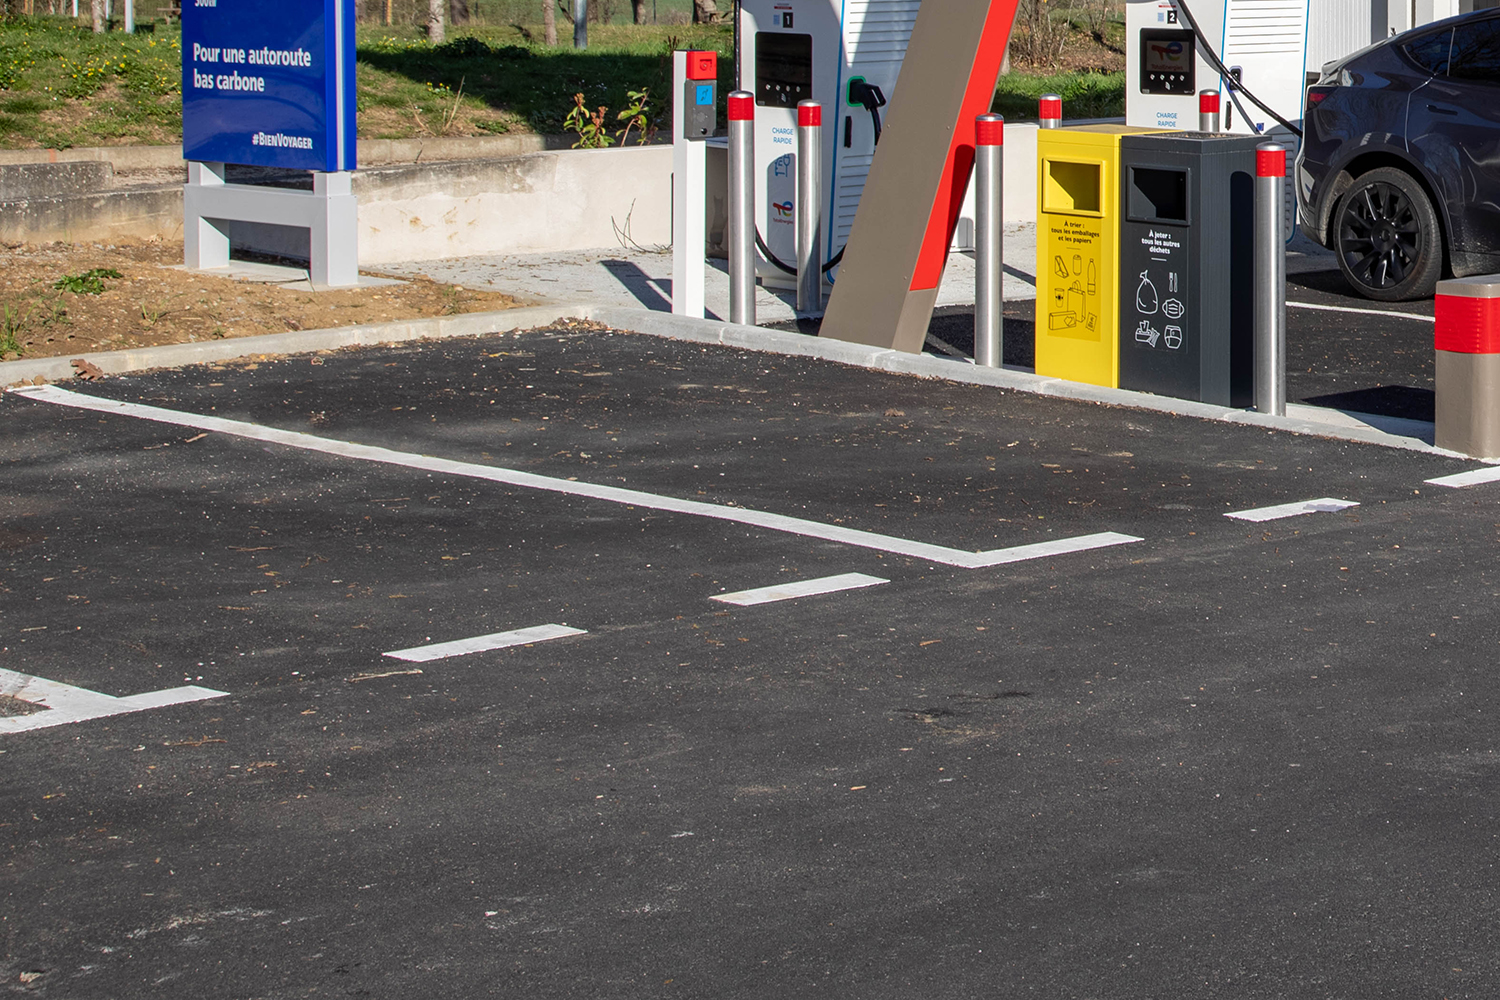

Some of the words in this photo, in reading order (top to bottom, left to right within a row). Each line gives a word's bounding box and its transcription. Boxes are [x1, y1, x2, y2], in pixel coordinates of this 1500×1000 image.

[1169, 12, 1175, 22] 2
[193, 43, 220, 63] Pour
[222, 48, 245, 64] une
[248, 46, 312, 67] autoroute
[193, 68, 214, 89] bas
[216, 70, 265, 92] carbone
[772, 127, 794, 135] CHARGE
[773, 137, 792, 145] RAPIDE
[1072, 229, 1100, 238] emballages
[1154, 231, 1168, 239] jeter
[1141, 237, 1153, 245] tous
[1154, 238, 1162, 246] les
[1163, 240, 1181, 248] autres
[1149, 245, 1171, 255] déchets
